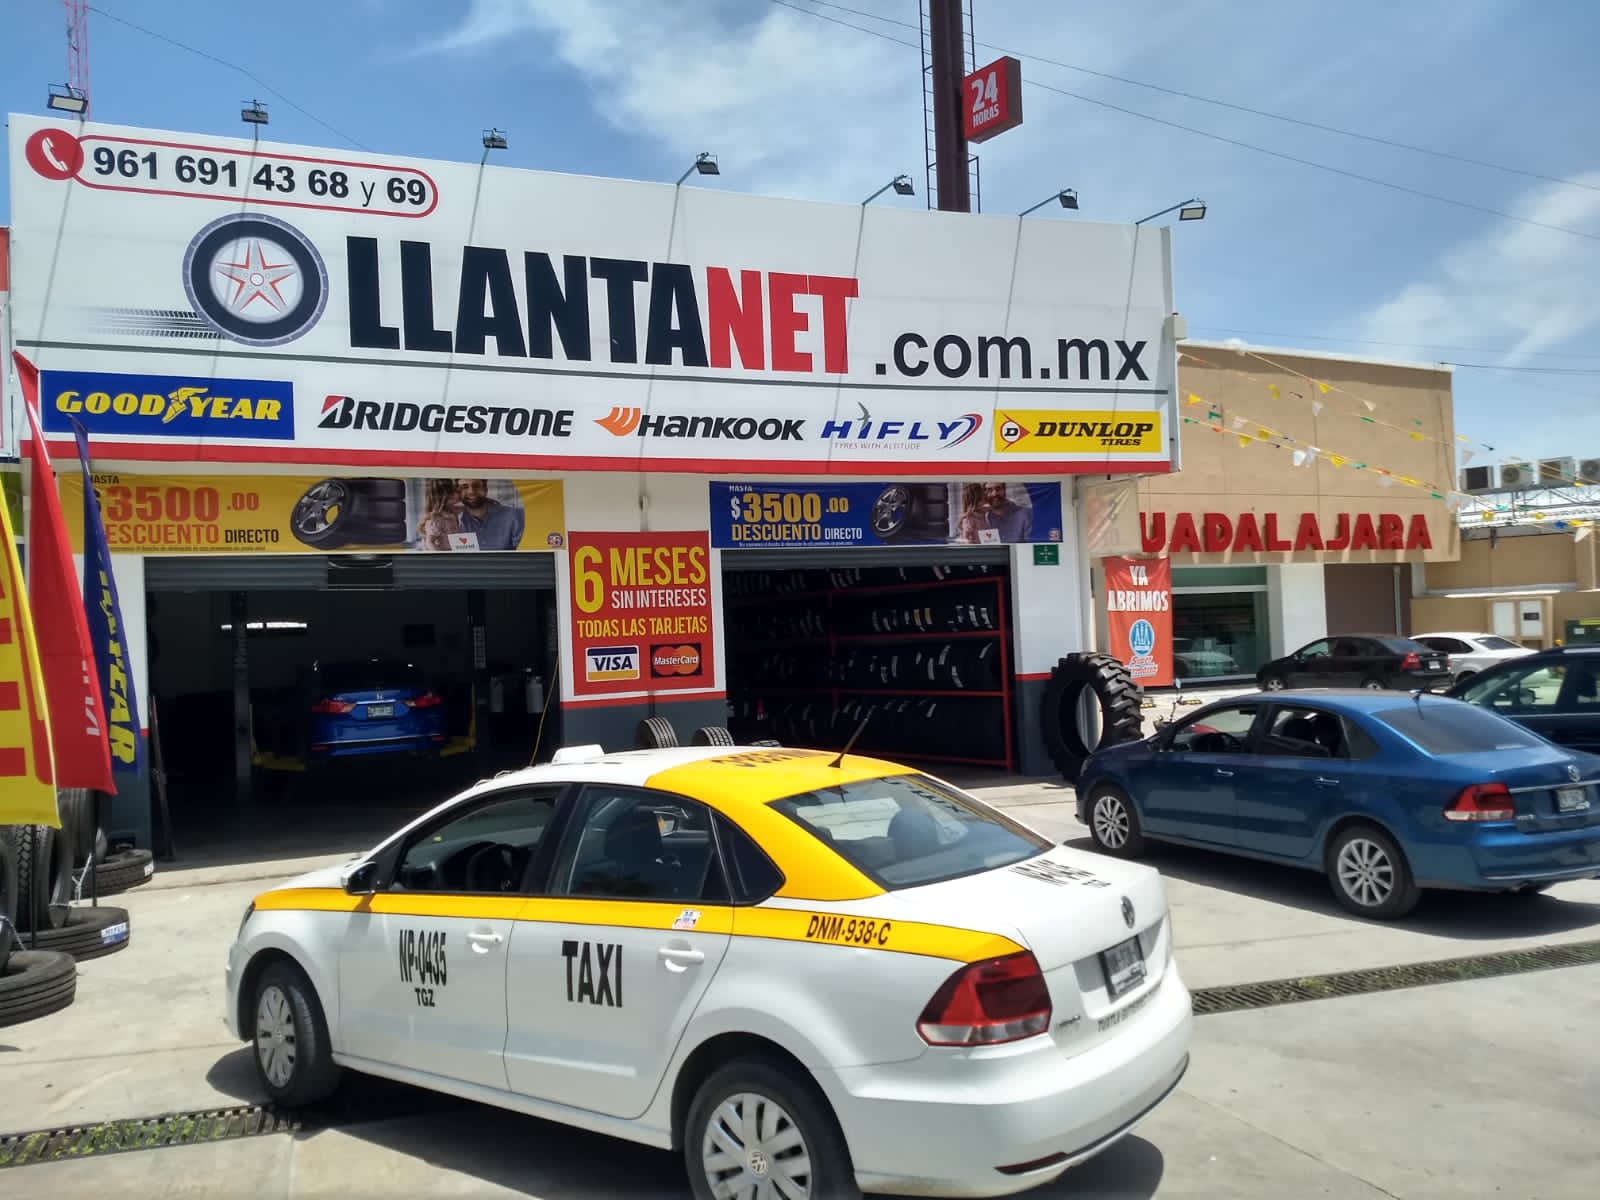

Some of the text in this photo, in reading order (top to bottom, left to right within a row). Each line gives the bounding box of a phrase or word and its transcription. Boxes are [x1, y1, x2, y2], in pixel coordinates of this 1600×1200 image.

[971, 72, 998, 113] 24
[972, 104, 1000, 128] HORAS
[94, 147, 426, 207] 961 691 43 68 y 69
[347, 235, 1150, 381] LLANTANET .com.mx
[318, 395, 574, 437] BRIDGESTONE
[821, 420, 962, 441] HIFLY
[1035, 422, 1154, 438] DUNLOP
[834, 441, 859, 449] TYRES
[882, 442, 921, 450] ALTITUDE
[1101, 438, 1141, 446] TIRES
[729, 485, 753, 493] HASTA
[105, 523, 279, 545] ESCUENTO DIRECTO
[731, 524, 863, 541] DESCUENTO DIRECTO
[1139, 511, 1433, 552] UADALAJARA
[610, 546, 706, 586] MESES
[1129, 565, 1149, 586] YA
[574, 545, 604, 613] 6
[611, 588, 707, 608] SIN INTERESES
[1107, 590, 1169, 611] ABRIMOS
[577, 615, 708, 638] TODAS LAS TARJETAS
[592, 655, 633, 671] VISA
[806, 915, 892, 946] DNM-938-C
[399, 928, 447, 986] NP-0435
[562, 940, 624, 1008] TAXI
[415, 987, 436, 1008] TGZ
